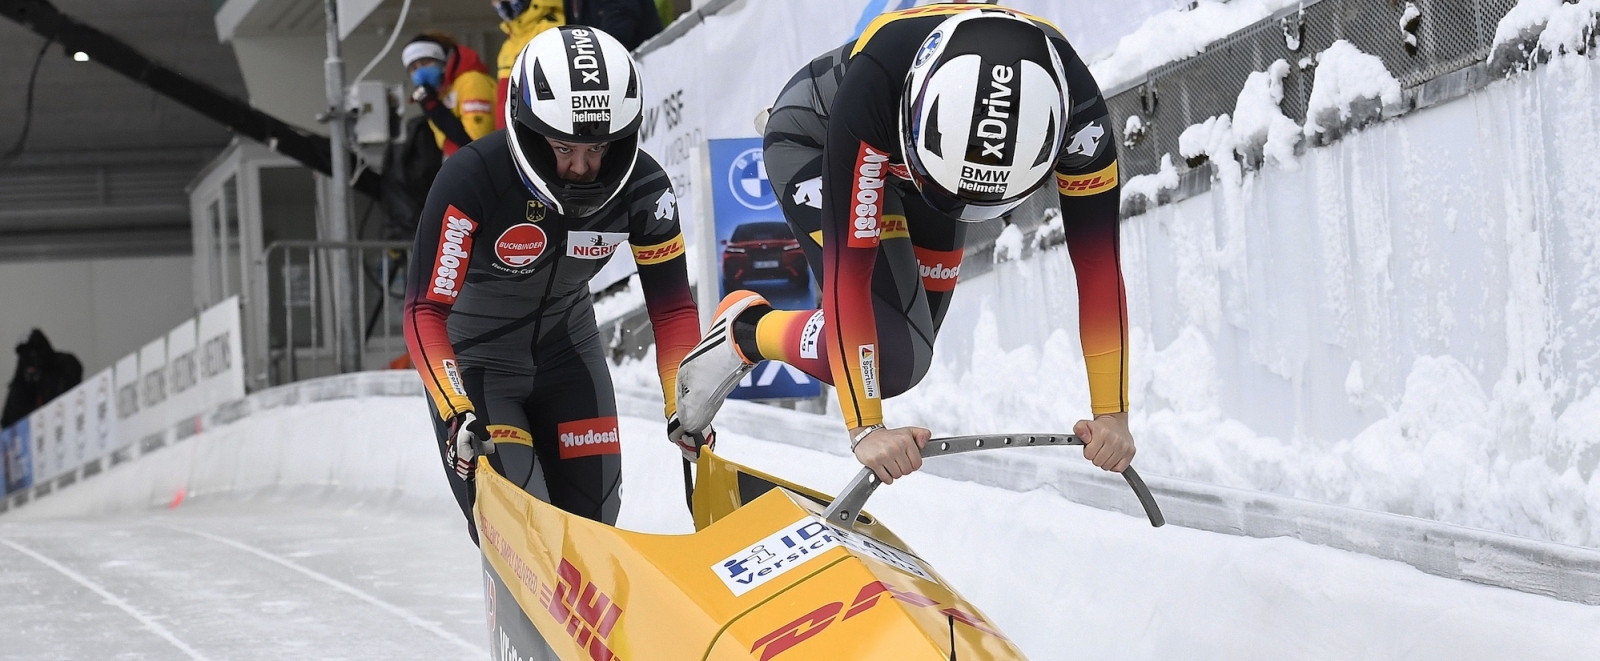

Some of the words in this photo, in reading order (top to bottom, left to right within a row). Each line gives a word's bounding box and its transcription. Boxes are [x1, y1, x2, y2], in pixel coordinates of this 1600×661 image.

[571, 28, 600, 84] xDrive
[571, 95, 610, 109] BMW
[572, 110, 610, 123] helmets
[977, 64, 1014, 160] xDrive
[961, 165, 1011, 182] BMW
[959, 179, 1007, 193] helmets
[1056, 176, 1105, 190] DHL
[854, 147, 890, 239] Nudossi
[881, 220, 906, 232] HL
[499, 241, 543, 250] BUCHBINDER
[637, 242, 680, 260] DHL
[432, 215, 474, 299] Nudossi
[491, 262, 536, 275] Rent-a-Car
[489, 429, 521, 439] HL
[560, 427, 619, 448] Nudossi
[549, 557, 623, 661] DHL
